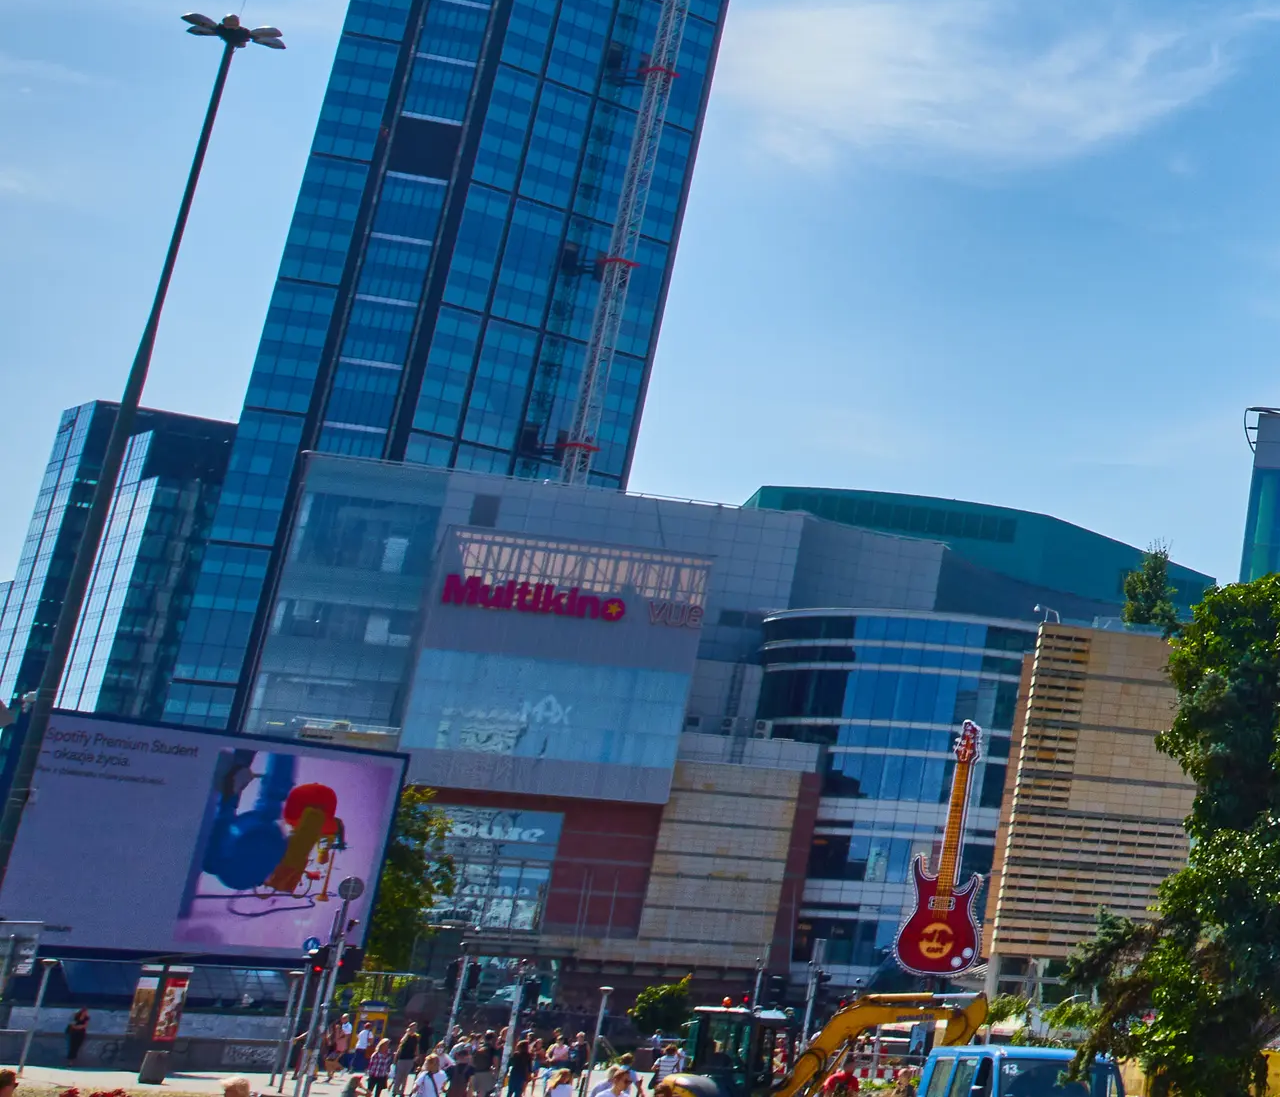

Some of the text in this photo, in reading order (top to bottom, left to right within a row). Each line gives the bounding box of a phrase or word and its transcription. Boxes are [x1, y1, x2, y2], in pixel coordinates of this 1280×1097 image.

[441, 573, 626, 622] Multikino
[45, 726, 199, 758] Spotify Premium Student
[1002, 1064, 1018, 1075] 13
